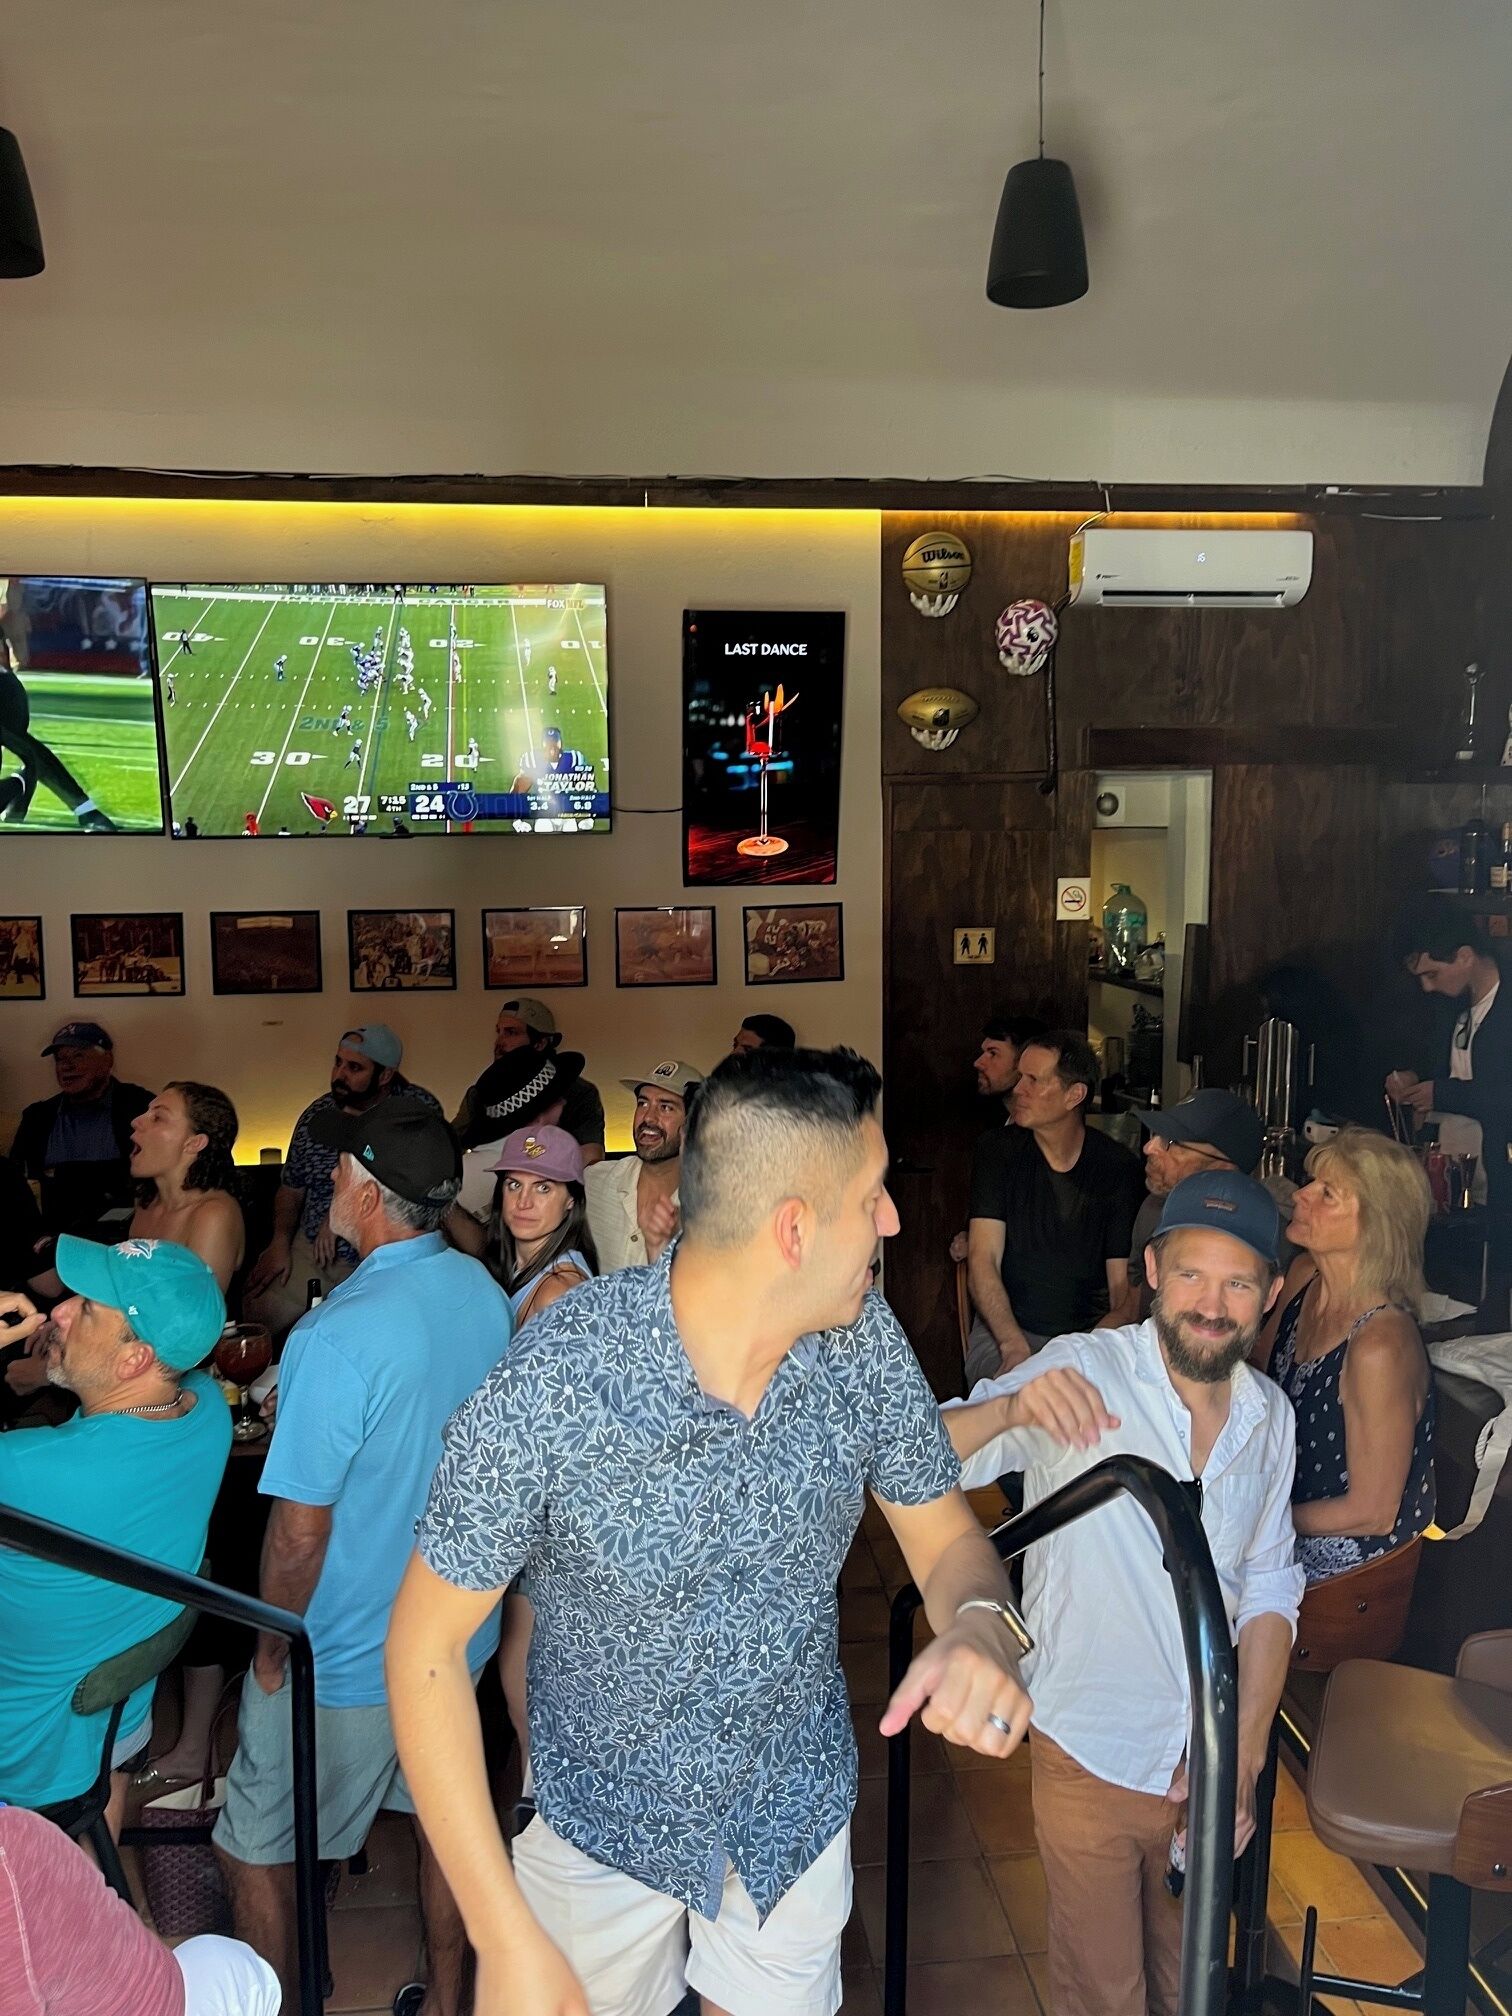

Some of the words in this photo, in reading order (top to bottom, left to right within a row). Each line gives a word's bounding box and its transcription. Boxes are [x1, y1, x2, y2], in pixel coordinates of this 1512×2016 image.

[547, 599, 565, 609] FOX
[724, 642, 759, 656] LAST
[761, 643, 808, 656] DANCE
[250, 751, 312, 766] 30
[421, 753, 478, 767] 20
[544, 773, 595, 781] JONATHAN
[544, 781, 596, 792] TAYLOR
[343, 795, 371, 814] 27
[380, 795, 407, 805] 7:15
[415, 794, 446, 813] 24
[531, 801, 548, 811] 3.4
